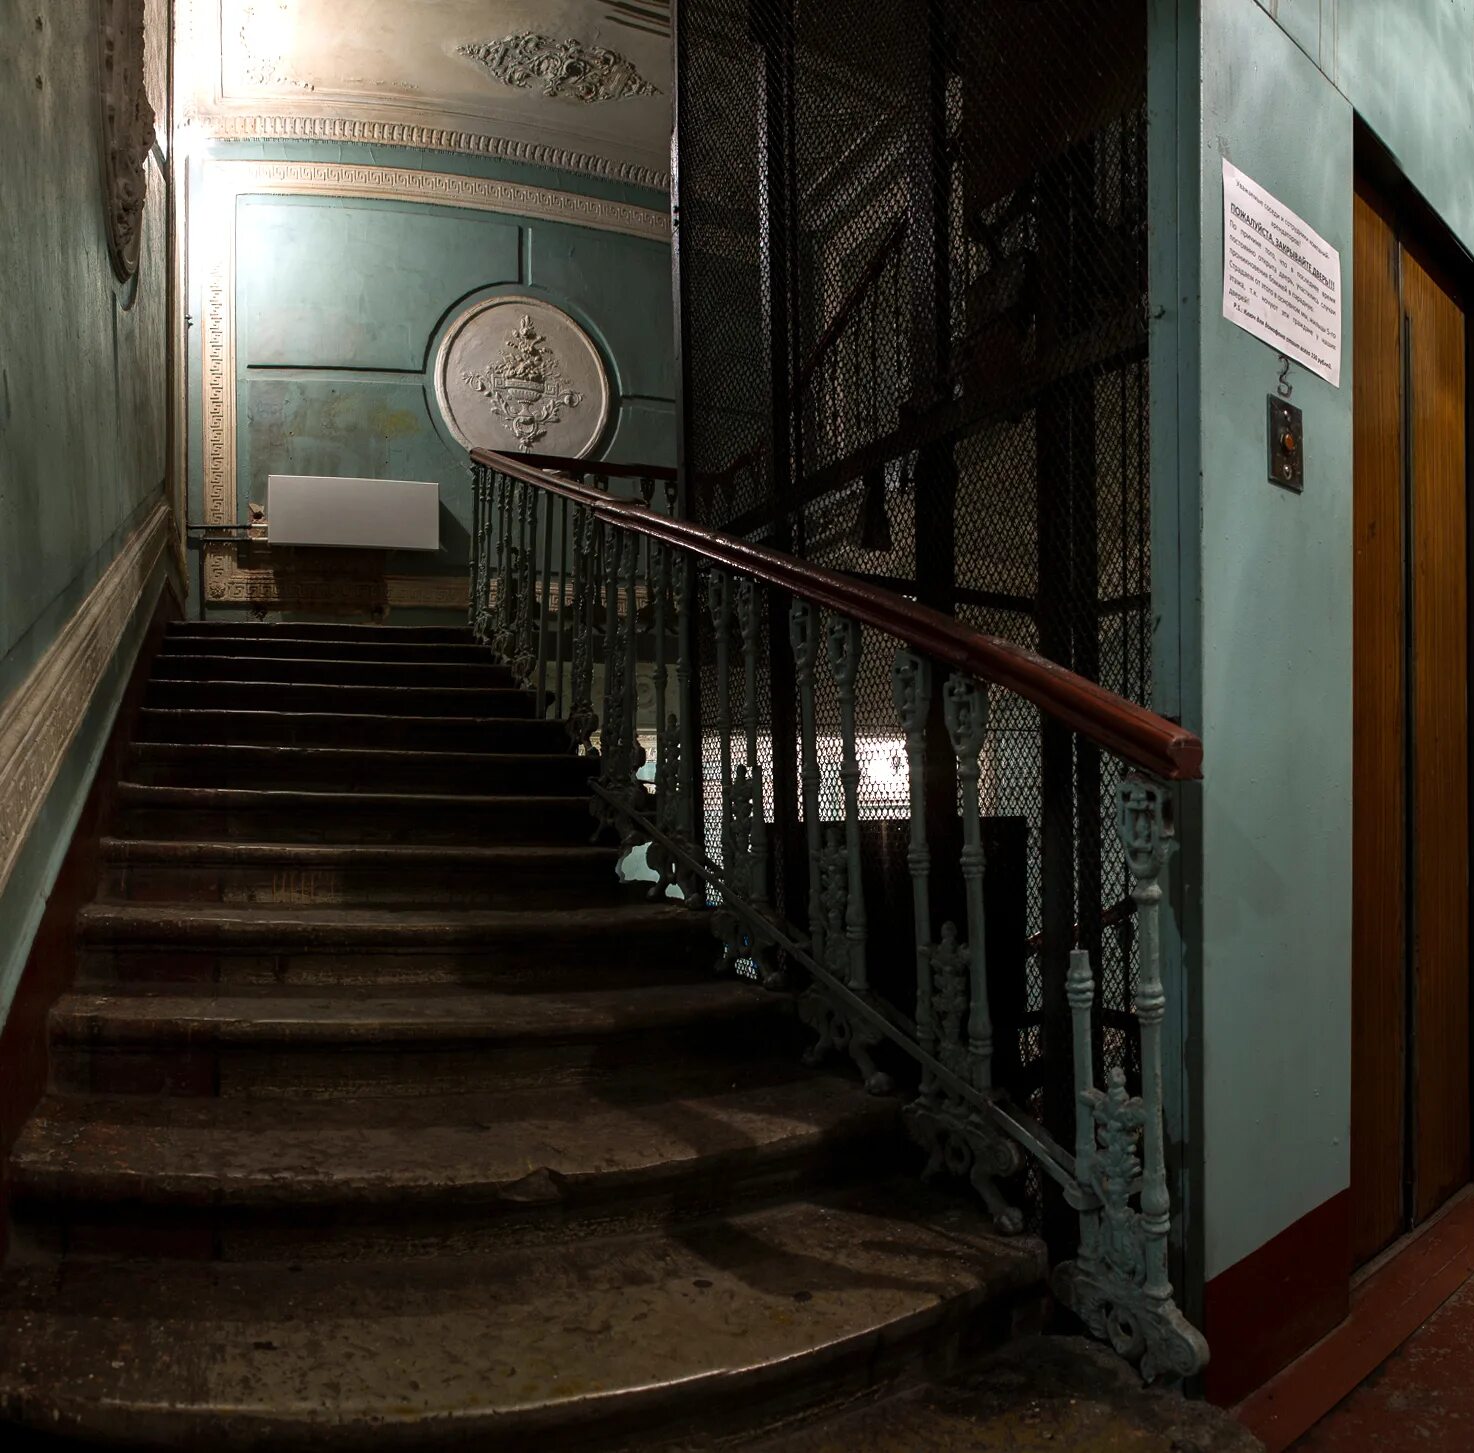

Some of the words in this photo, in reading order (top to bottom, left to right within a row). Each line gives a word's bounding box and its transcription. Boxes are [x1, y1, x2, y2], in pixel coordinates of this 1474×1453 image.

[1231, 202, 1274, 243] ПОЖАЛУЙСТА,
[1276, 238, 1311, 271] ЗАКРЫВАЙТЕ
[1312, 267, 1335, 289] ДВЕРЬ!!!
